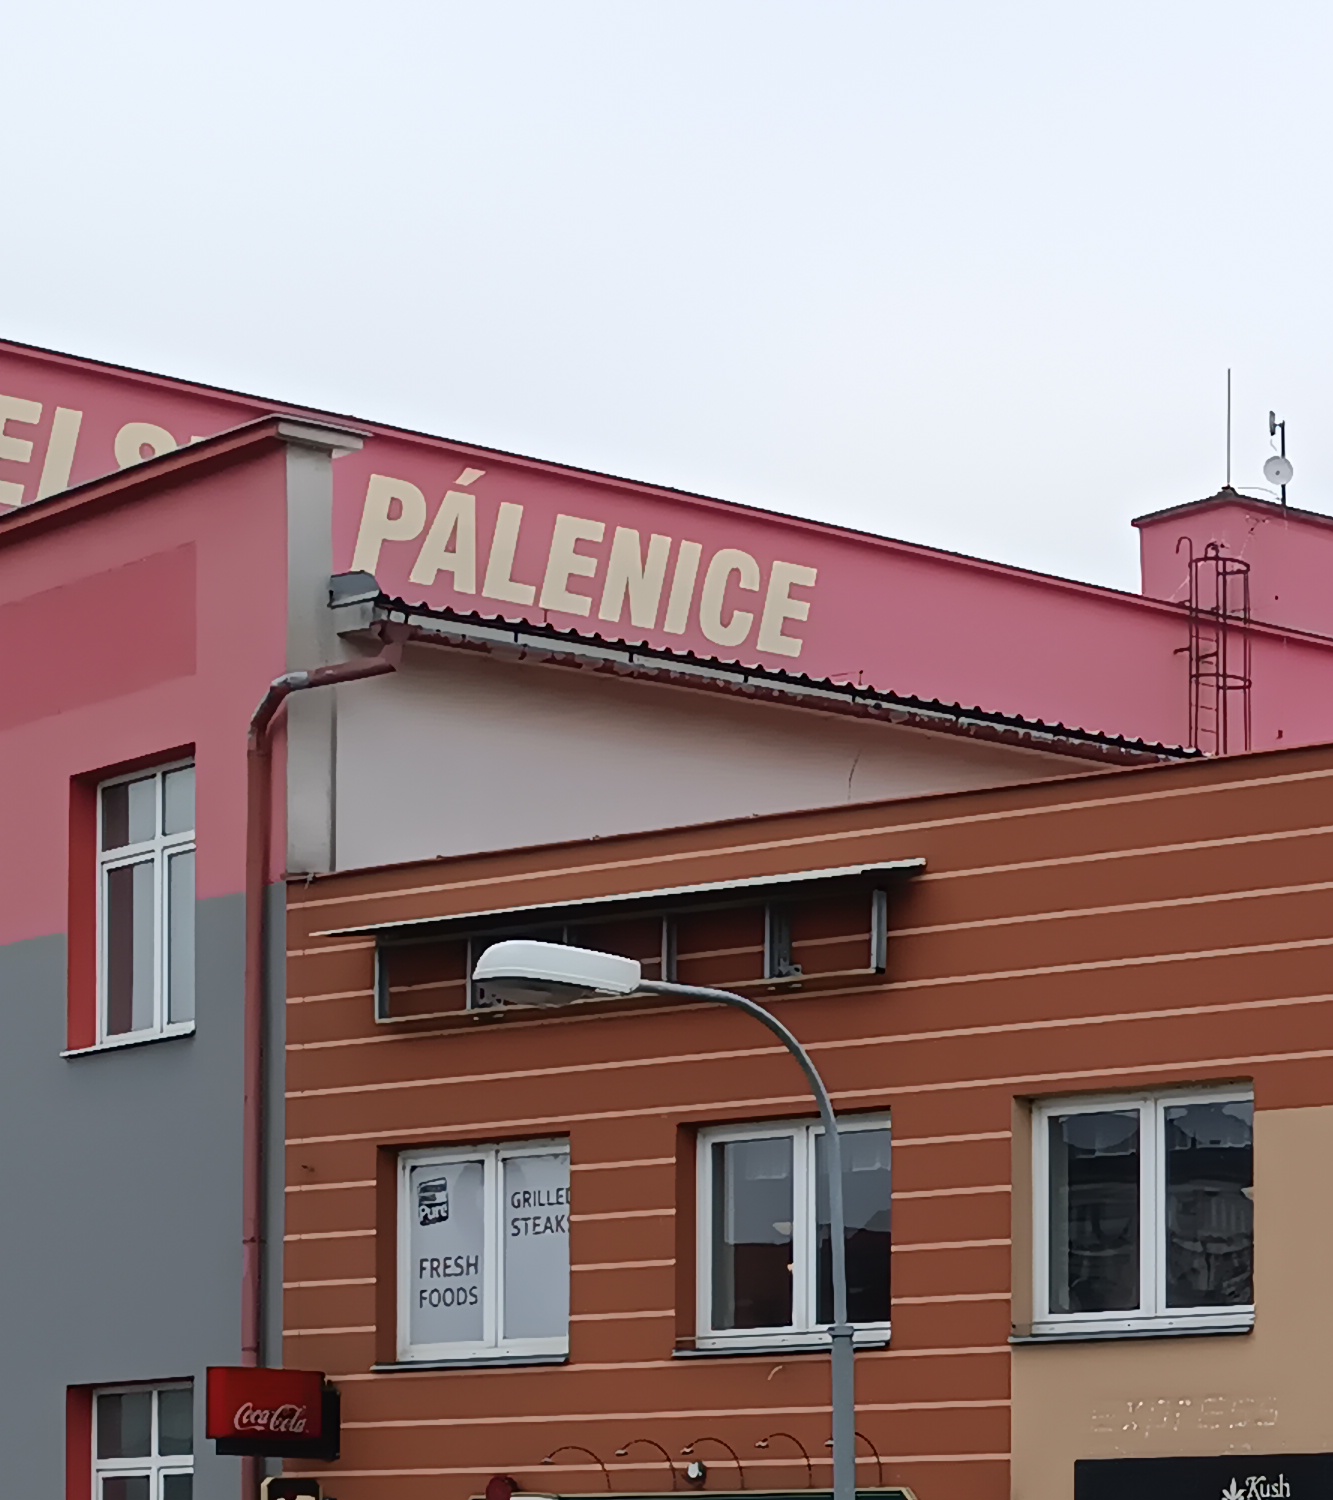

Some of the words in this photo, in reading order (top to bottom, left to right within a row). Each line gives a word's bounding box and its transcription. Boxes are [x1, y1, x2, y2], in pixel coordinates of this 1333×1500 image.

[350, 467, 818, 658] PÁLENICE
[511, 1214, 570, 1237] STEAK
[419, 1255, 479, 1279] FRESH
[419, 1286, 479, 1308] FOODS
